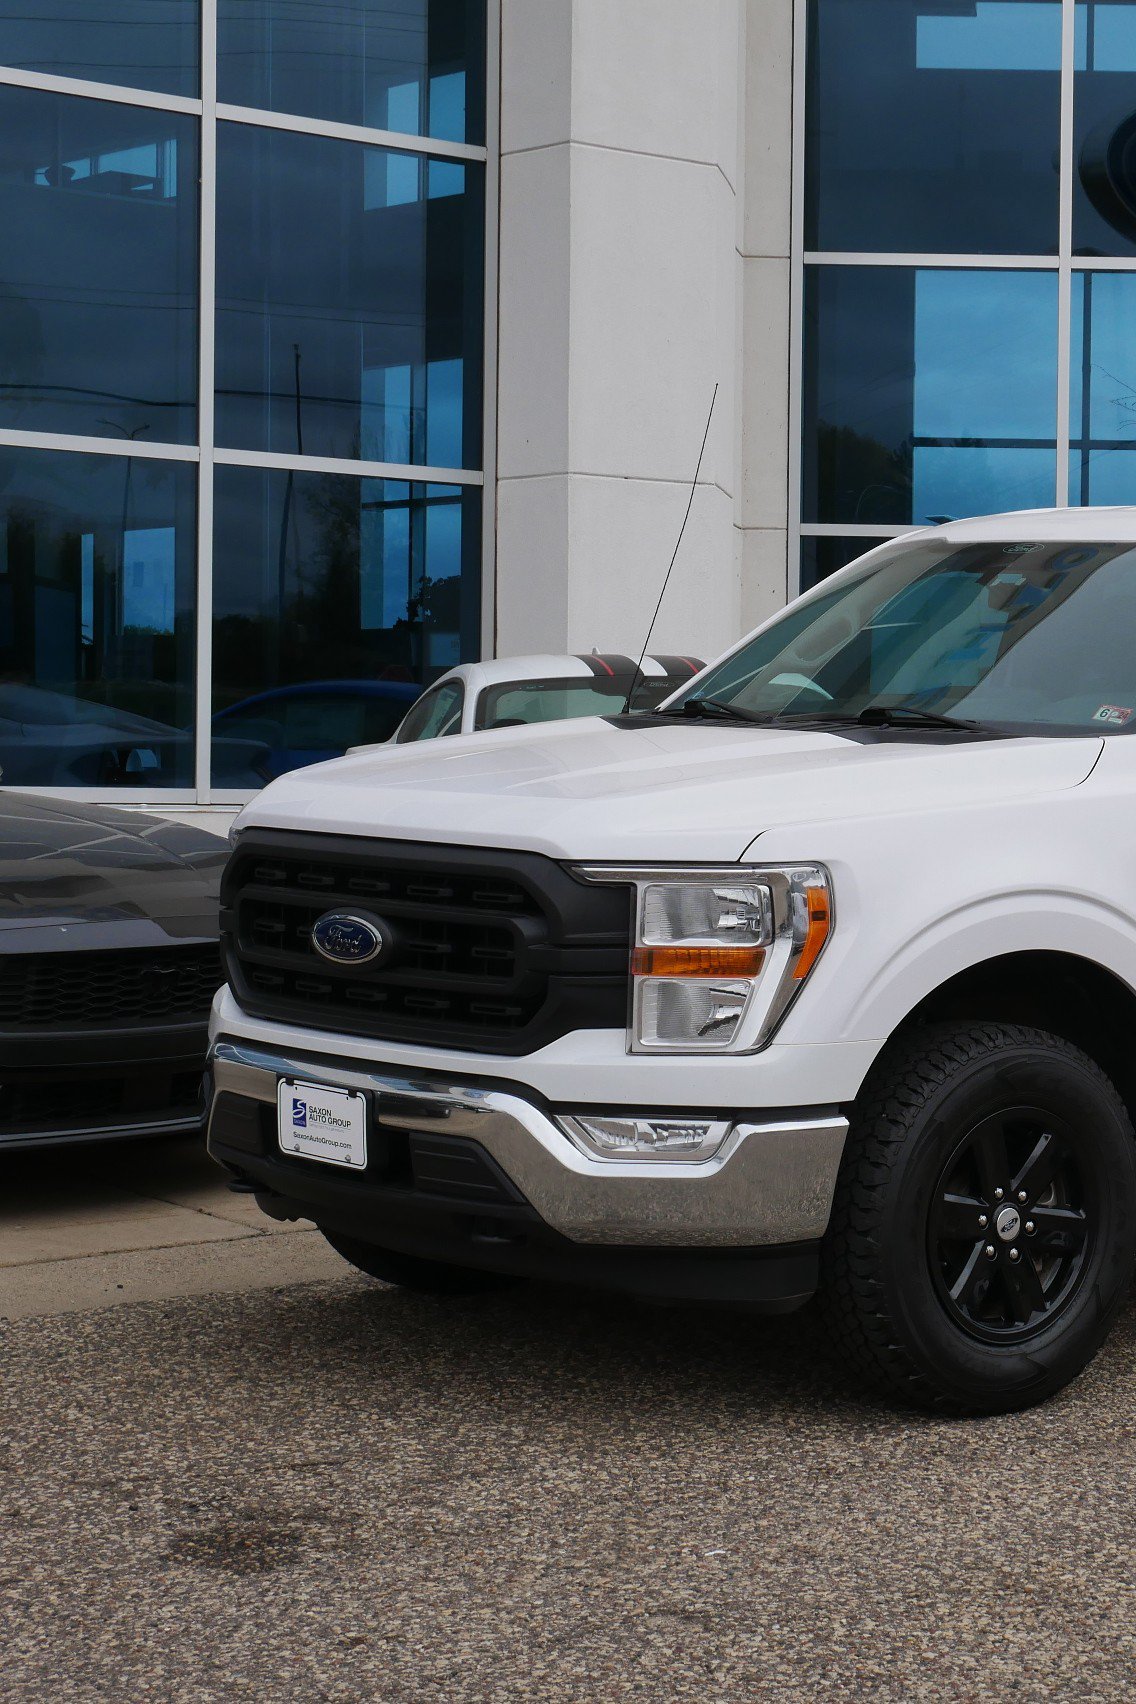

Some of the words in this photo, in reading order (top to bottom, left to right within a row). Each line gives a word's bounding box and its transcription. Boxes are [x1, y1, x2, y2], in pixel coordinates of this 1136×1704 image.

[1100, 708, 1111, 718] 6
[325, 924, 363, 953] Ford
[308, 1105, 332, 1117] SAXON
[308, 1115, 327, 1124] AUTO
[327, 1117, 352, 1129] GROUP
[293, 1131, 353, 1150] SaxonAutoGroup.com
